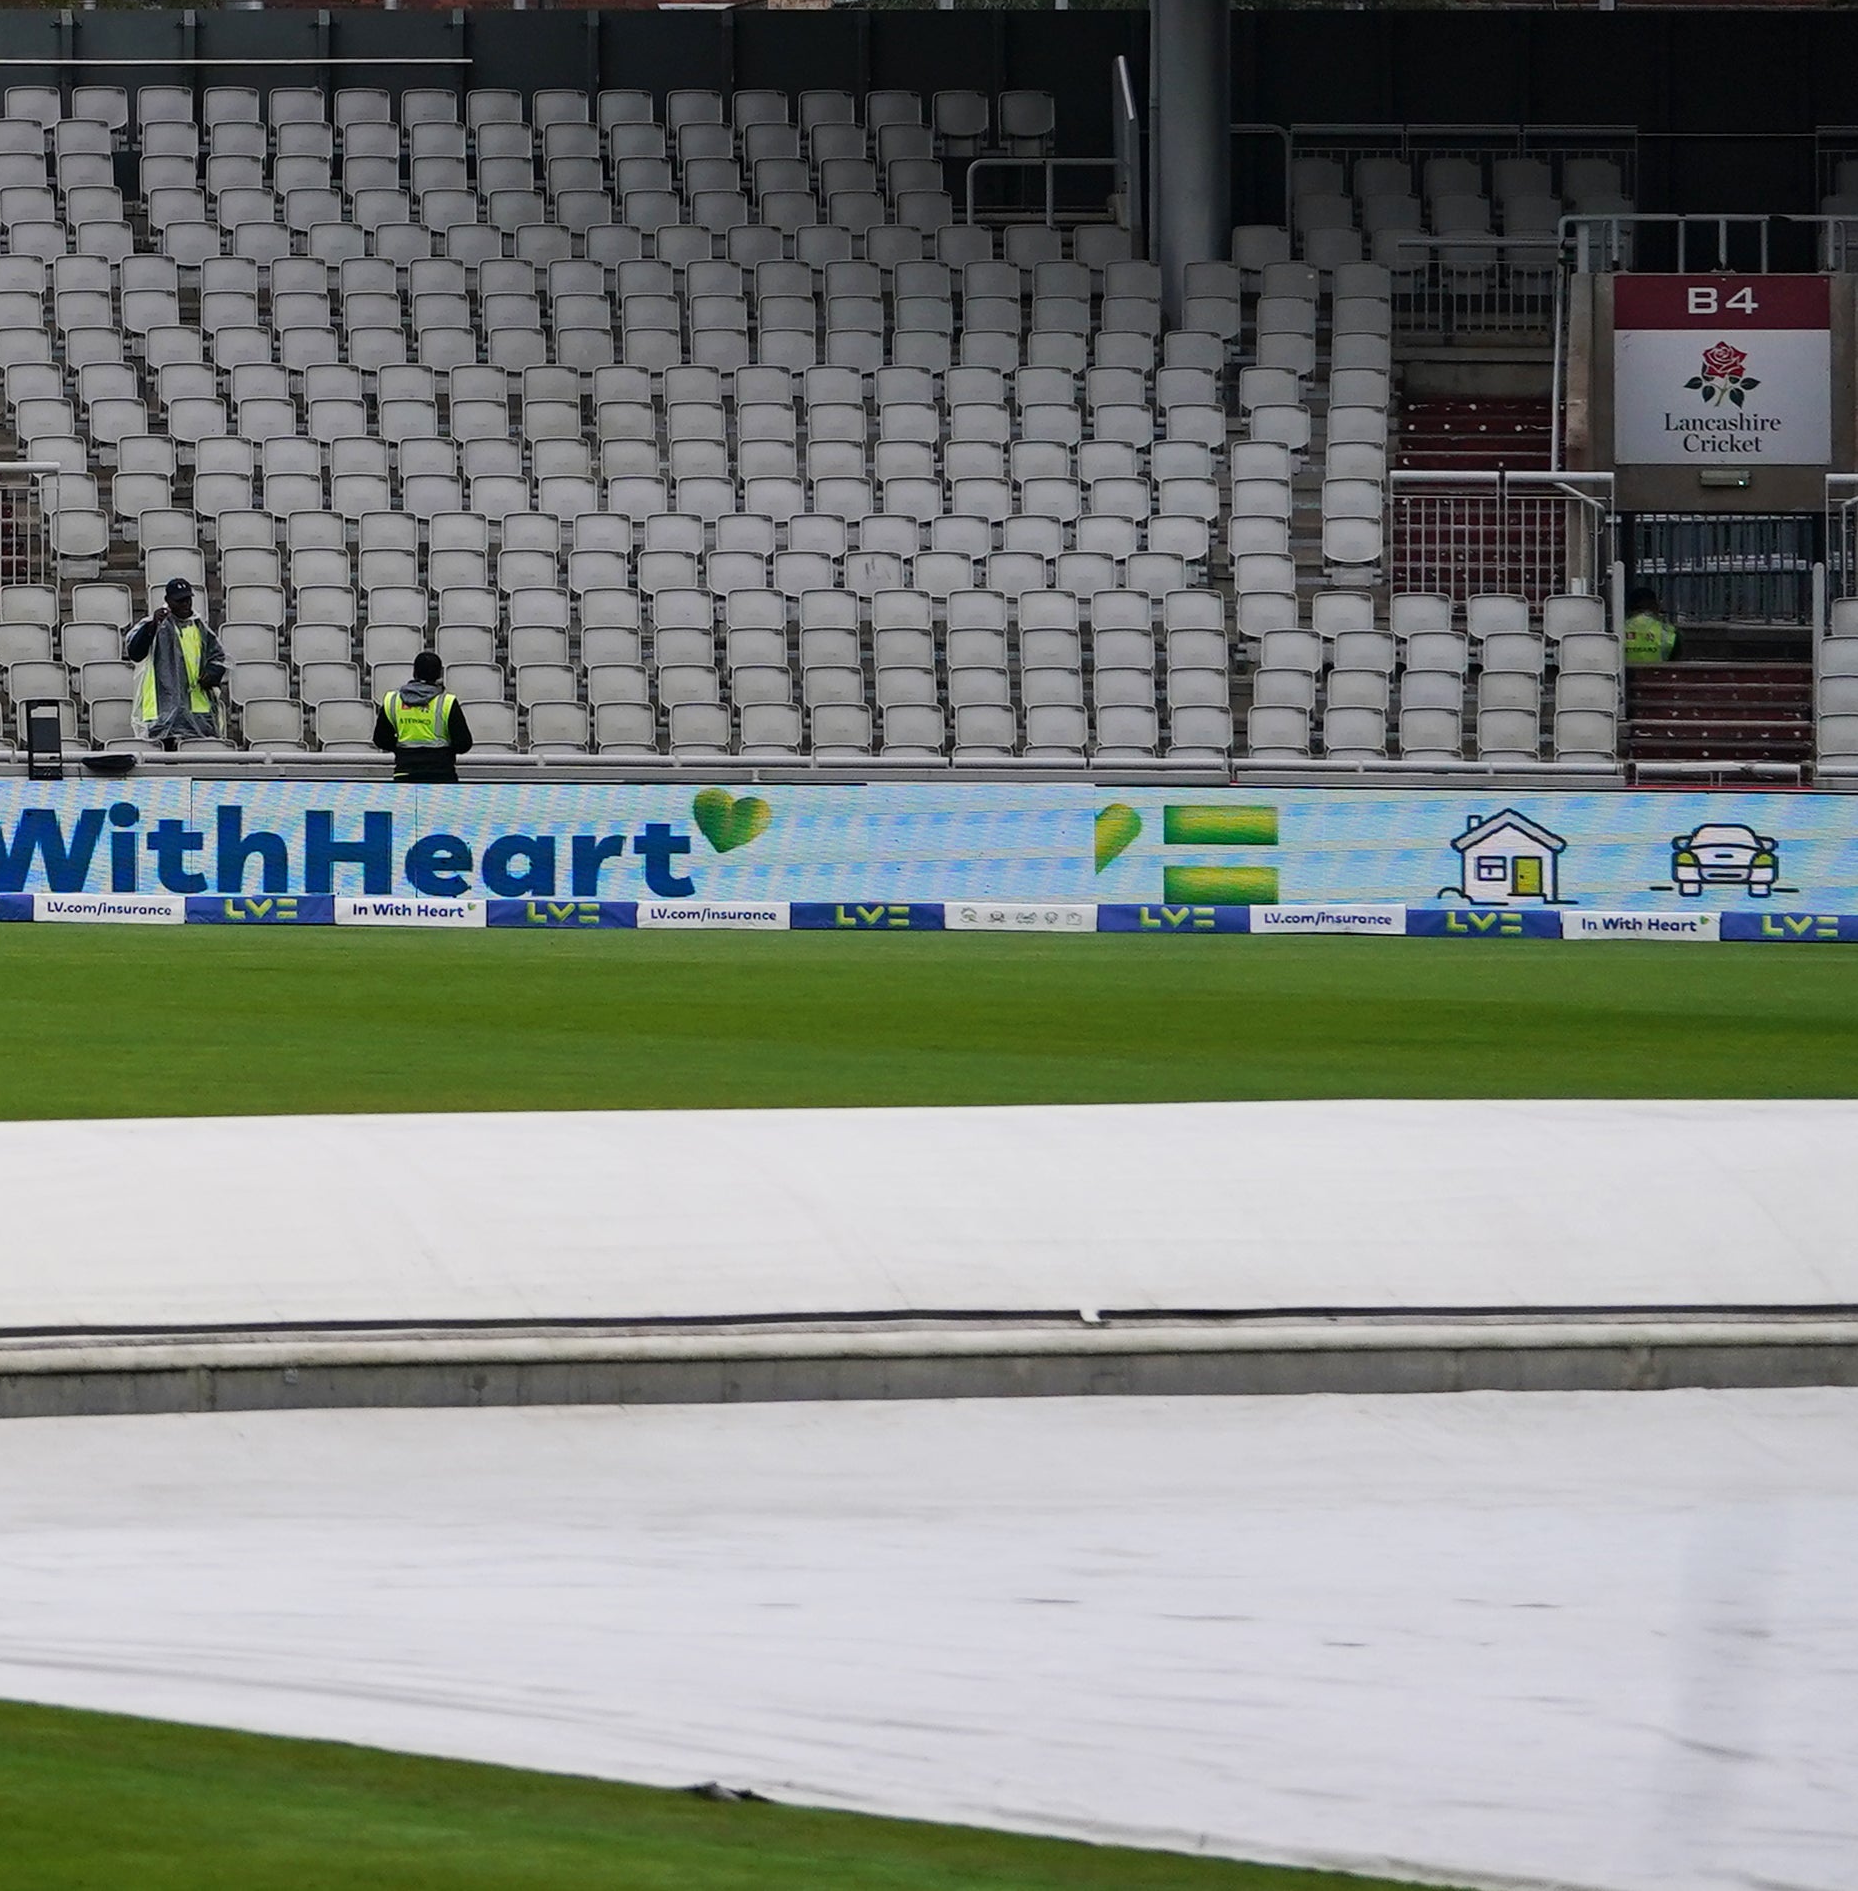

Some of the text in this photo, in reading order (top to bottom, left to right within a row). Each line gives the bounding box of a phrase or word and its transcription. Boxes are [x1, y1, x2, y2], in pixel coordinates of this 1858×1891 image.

[1687, 286, 1760, 315] B4
[1664, 412, 1782, 432] Lancashire
[1682, 433, 1763, 454] Cricket
[47, 901, 172, 917] LV.com/insurance
[352, 903, 465, 918] In With Heart
[650, 907, 777, 923] LV.com/insurance
[1263, 911, 1393, 927] LV.com/insurance
[1581, 917, 1698, 934] In With Heart
